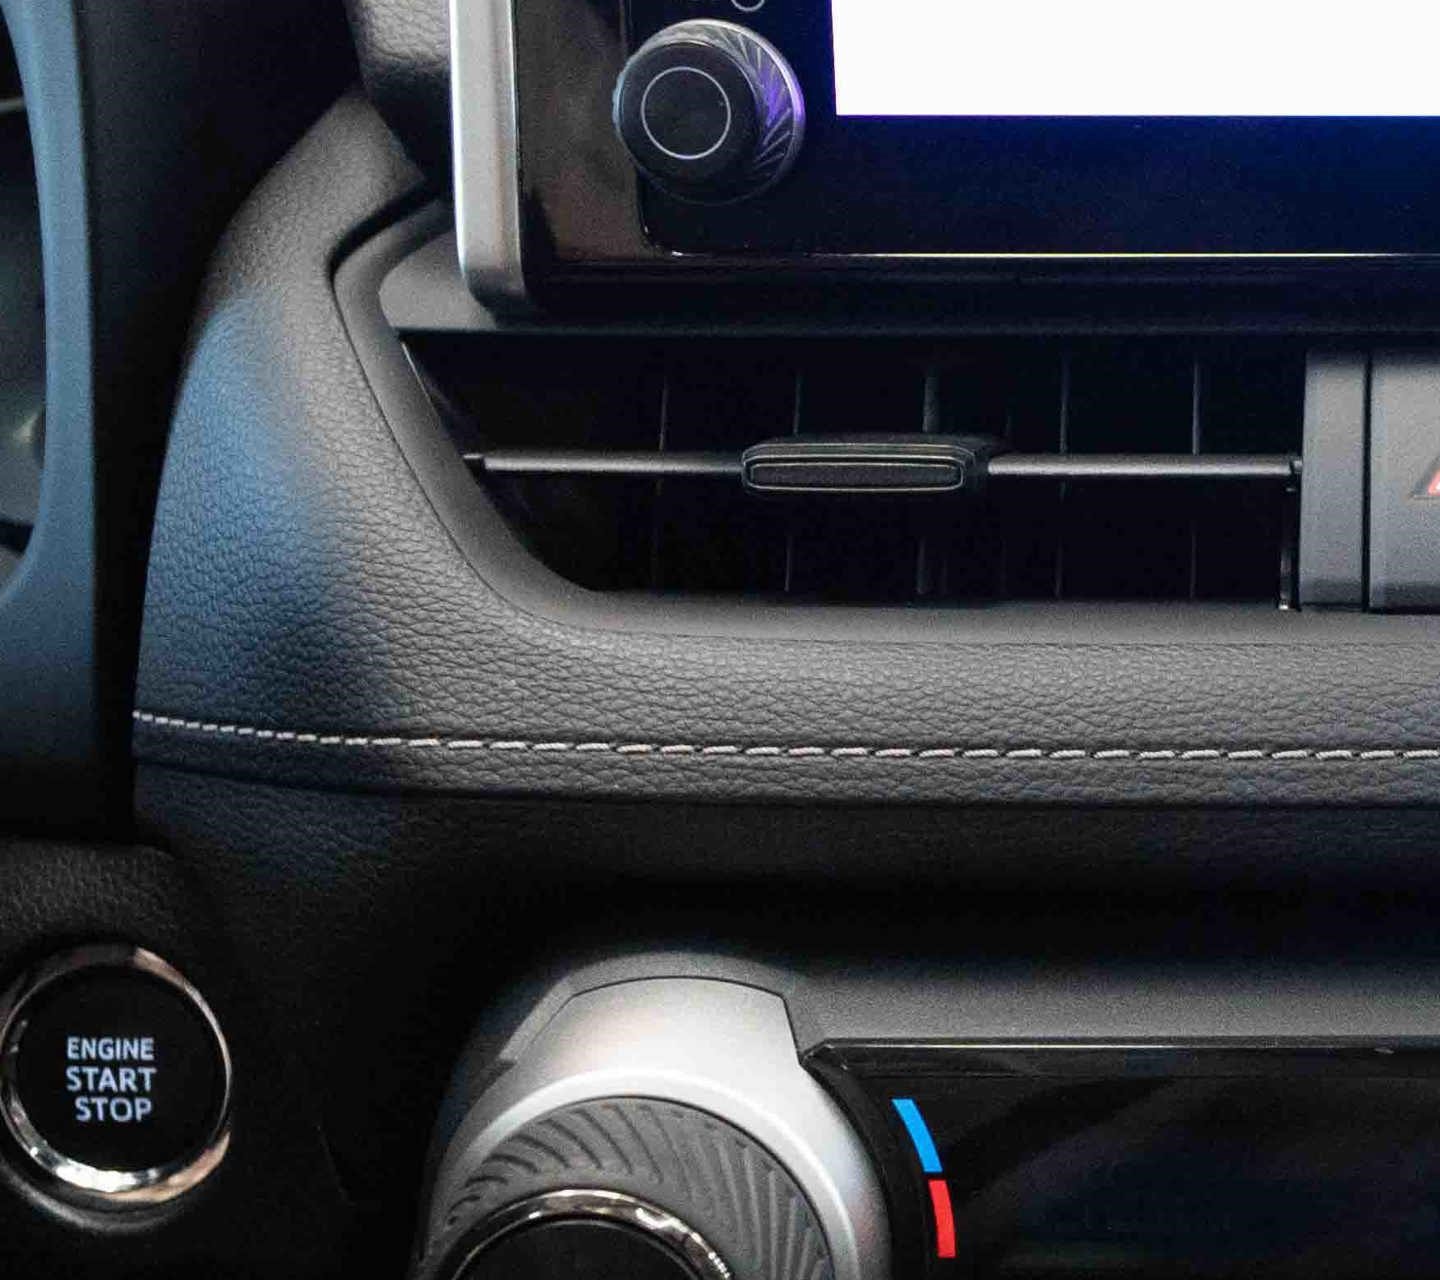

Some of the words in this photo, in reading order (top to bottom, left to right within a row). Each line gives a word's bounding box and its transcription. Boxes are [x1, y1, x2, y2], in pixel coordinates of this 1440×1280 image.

[67, 1036, 155, 1061] ENGINE
[65, 1066, 157, 1092] START
[74, 1096, 152, 1122] STOP
